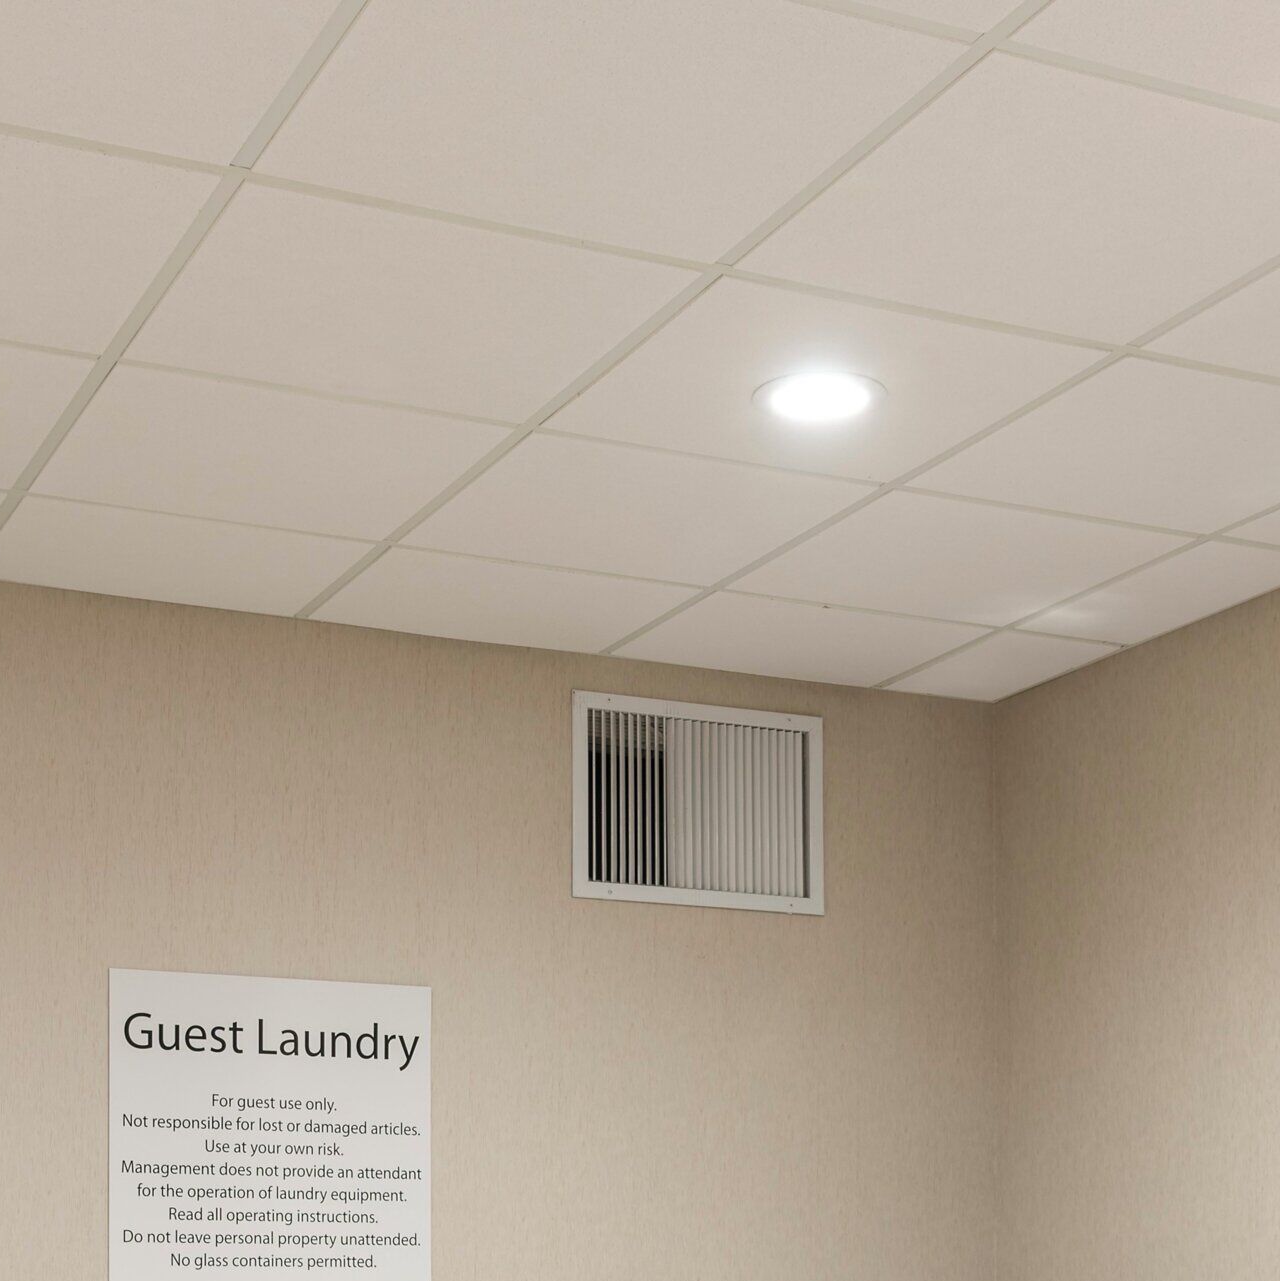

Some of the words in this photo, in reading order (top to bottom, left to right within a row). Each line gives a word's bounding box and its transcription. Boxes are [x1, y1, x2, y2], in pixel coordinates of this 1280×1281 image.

[123, 1013, 244, 1055] Guest
[257, 1019, 420, 1072] Laundry
[211, 1094, 234, 1108] For
[237, 1098, 276, 1112] guest
[279, 1100, 303, 1110] use
[305, 1098, 337, 1115] only.
[122, 1114, 149, 1128] Not
[152, 1116, 233, 1133] responsible
[235, 1117, 256, 1131] for
[258, 1118, 284, 1132] lost
[286, 1123, 301, 1133] or
[304, 1120, 367, 1138] damaged
[370, 1122, 421, 1136] articles.
[205, 1139, 231, 1154] Use
[233, 1142, 247, 1154] at
[250, 1144, 282, 1158] your
[284, 1145, 314, 1156] own
[317, 1143, 344, 1156] risk.
[121, 1160, 216, 1178] Management
[218, 1162, 253, 1177] does
[255, 1166, 279, 1177] not
[282, 1165, 334, 1181] provide
[337, 1169, 354, 1179] an
[357, 1166, 422, 1181] attendant
[137, 1183, 157, 1197] for
[160, 1184, 184, 1198] the
[187, 1186, 255, 1202] operation
[258, 1186, 273, 1200] of
[276, 1187, 328, 1204] laundry
[330, 1189, 407, 1205] equipment.
[168, 1207, 203, 1221] Read
[206, 1208, 223, 1222] all
[226, 1209, 293, 1226] operating
[297, 1210, 378, 1224] instructions.
[123, 1230, 144, 1244] Do
[147, 1232, 172, 1244] not
[175, 1230, 211, 1244] leave
[215, 1231, 274, 1248] personal
[278, 1234, 337, 1249] property
[340, 1233, 421, 1247] unattended.
[170, 1253, 191, 1267] No
[194, 1253, 229, 1271] glass
[231, 1255, 304, 1268] containers
[307, 1255, 377, 1271] permitted.
